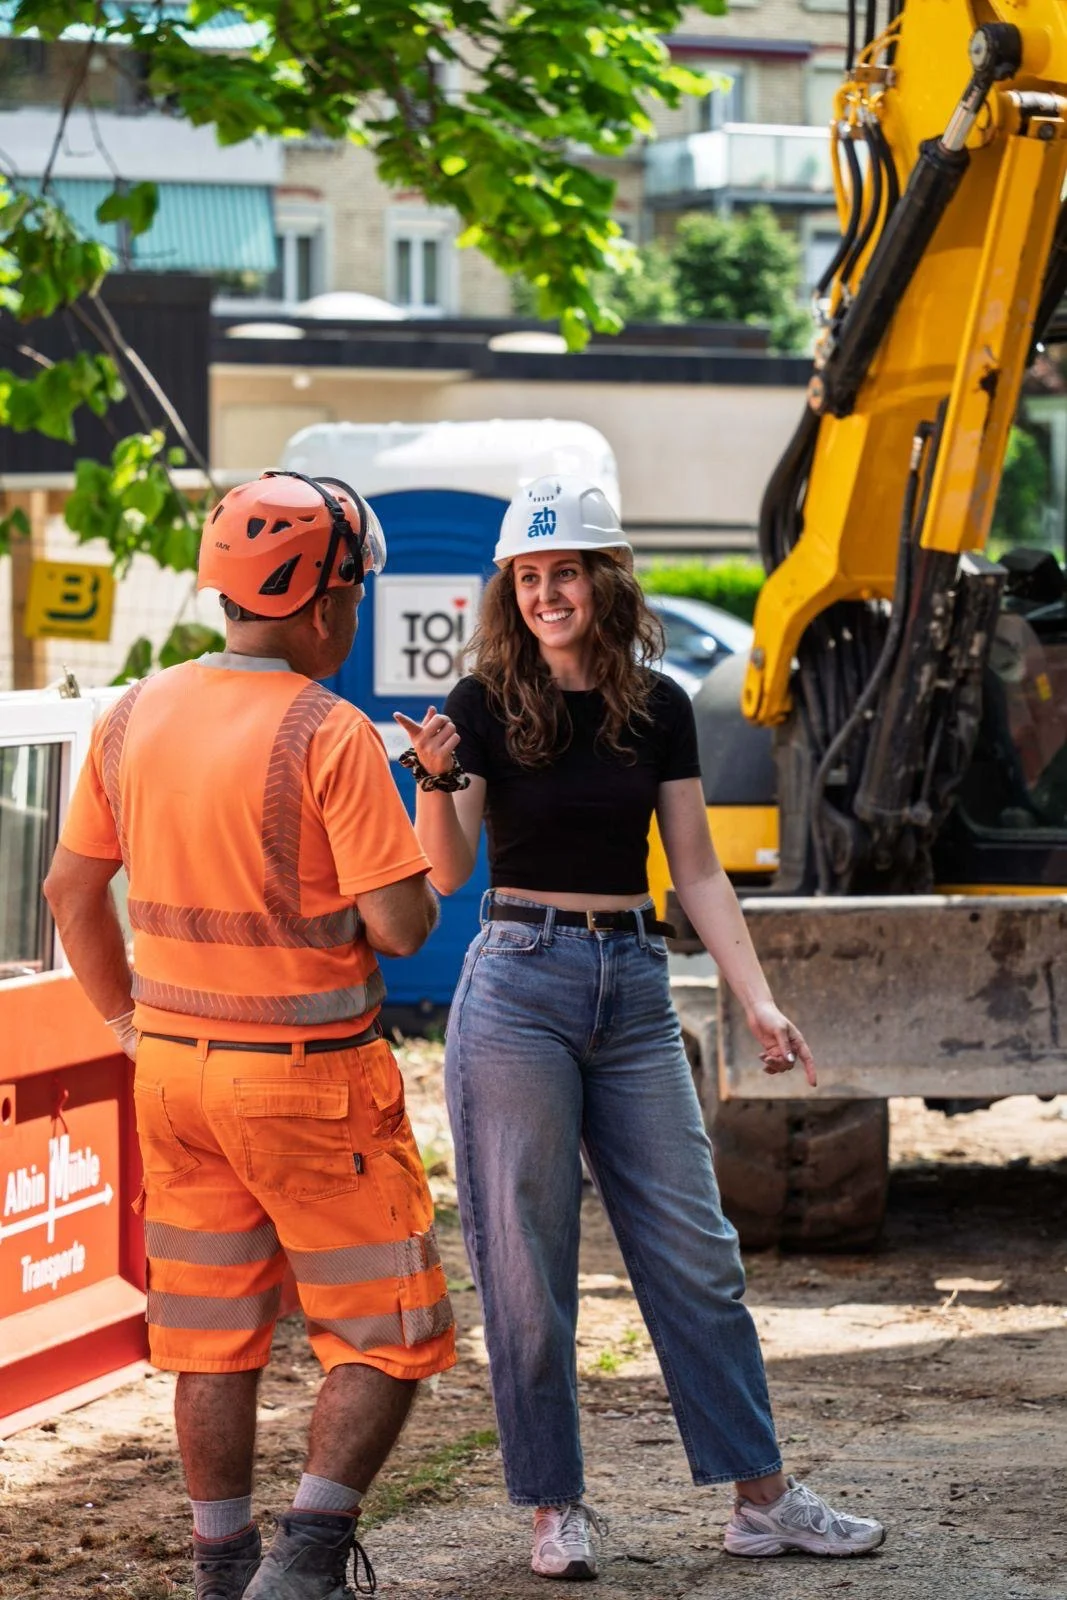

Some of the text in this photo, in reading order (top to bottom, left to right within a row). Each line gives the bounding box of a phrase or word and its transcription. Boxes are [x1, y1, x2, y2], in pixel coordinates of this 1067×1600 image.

[532, 507, 556, 524] zh
[528, 522, 556, 538] aw
[4, 1165, 46, 1216] Albin
